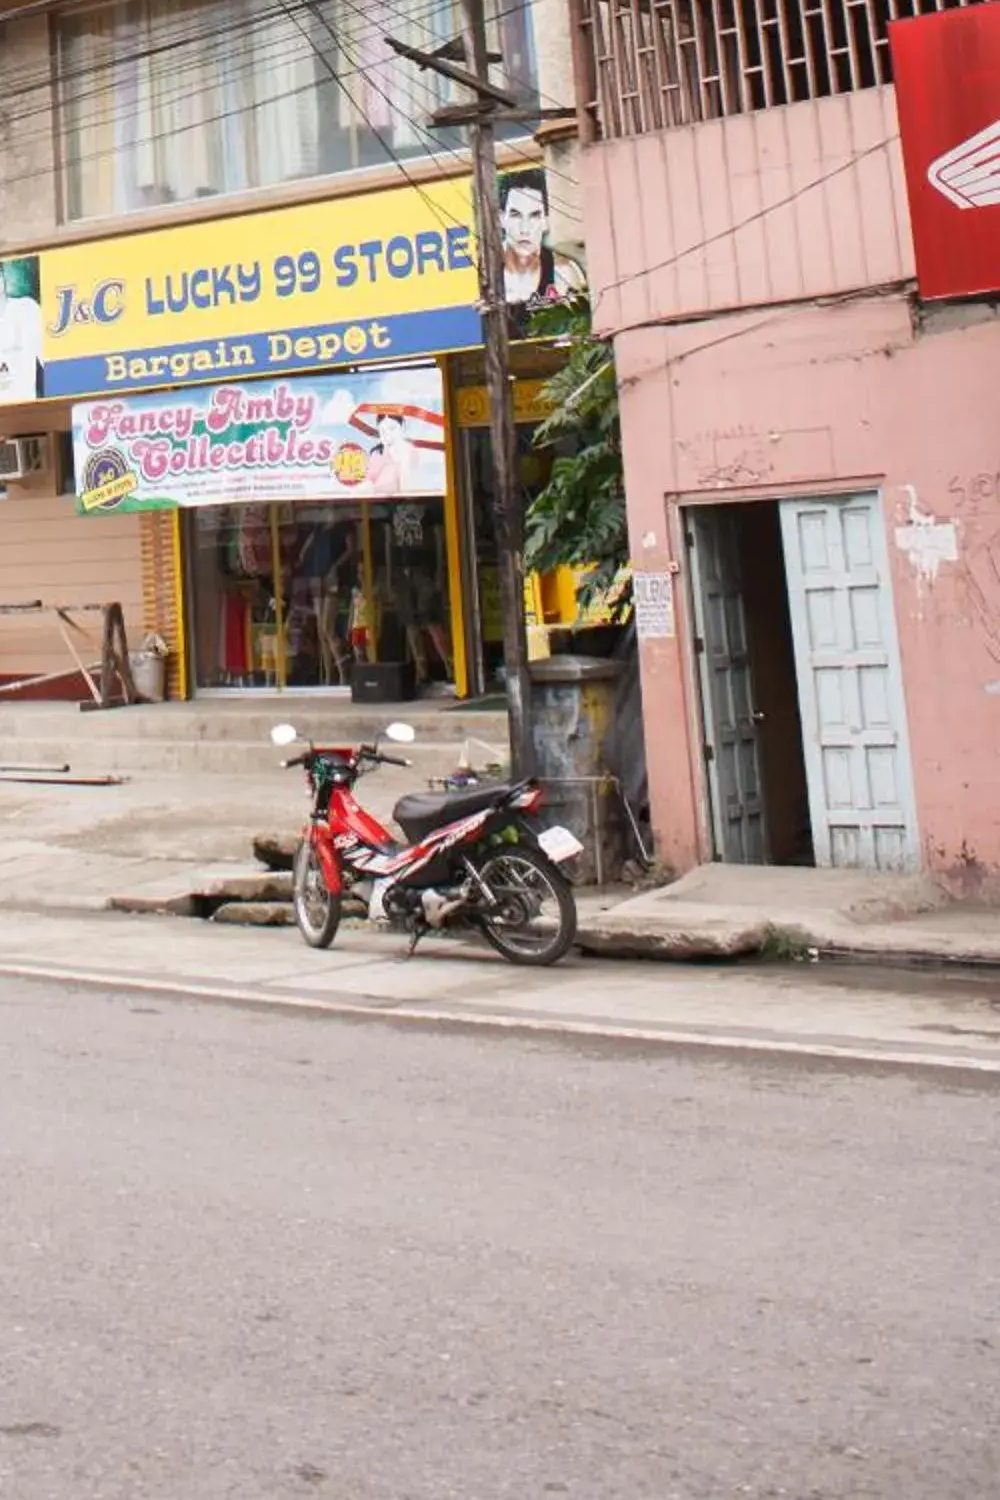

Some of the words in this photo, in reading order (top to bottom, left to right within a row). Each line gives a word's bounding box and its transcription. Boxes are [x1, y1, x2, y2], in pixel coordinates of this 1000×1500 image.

[48, 276, 125, 337] J&C
[146, 260, 262, 315] LUCKY
[273, 250, 322, 297] 99
[333, 226, 475, 288] STORE
[104, 341, 256, 381] Bargain
[268, 320, 392, 361] Depot
[132, 430, 332, 479] Collectibles
